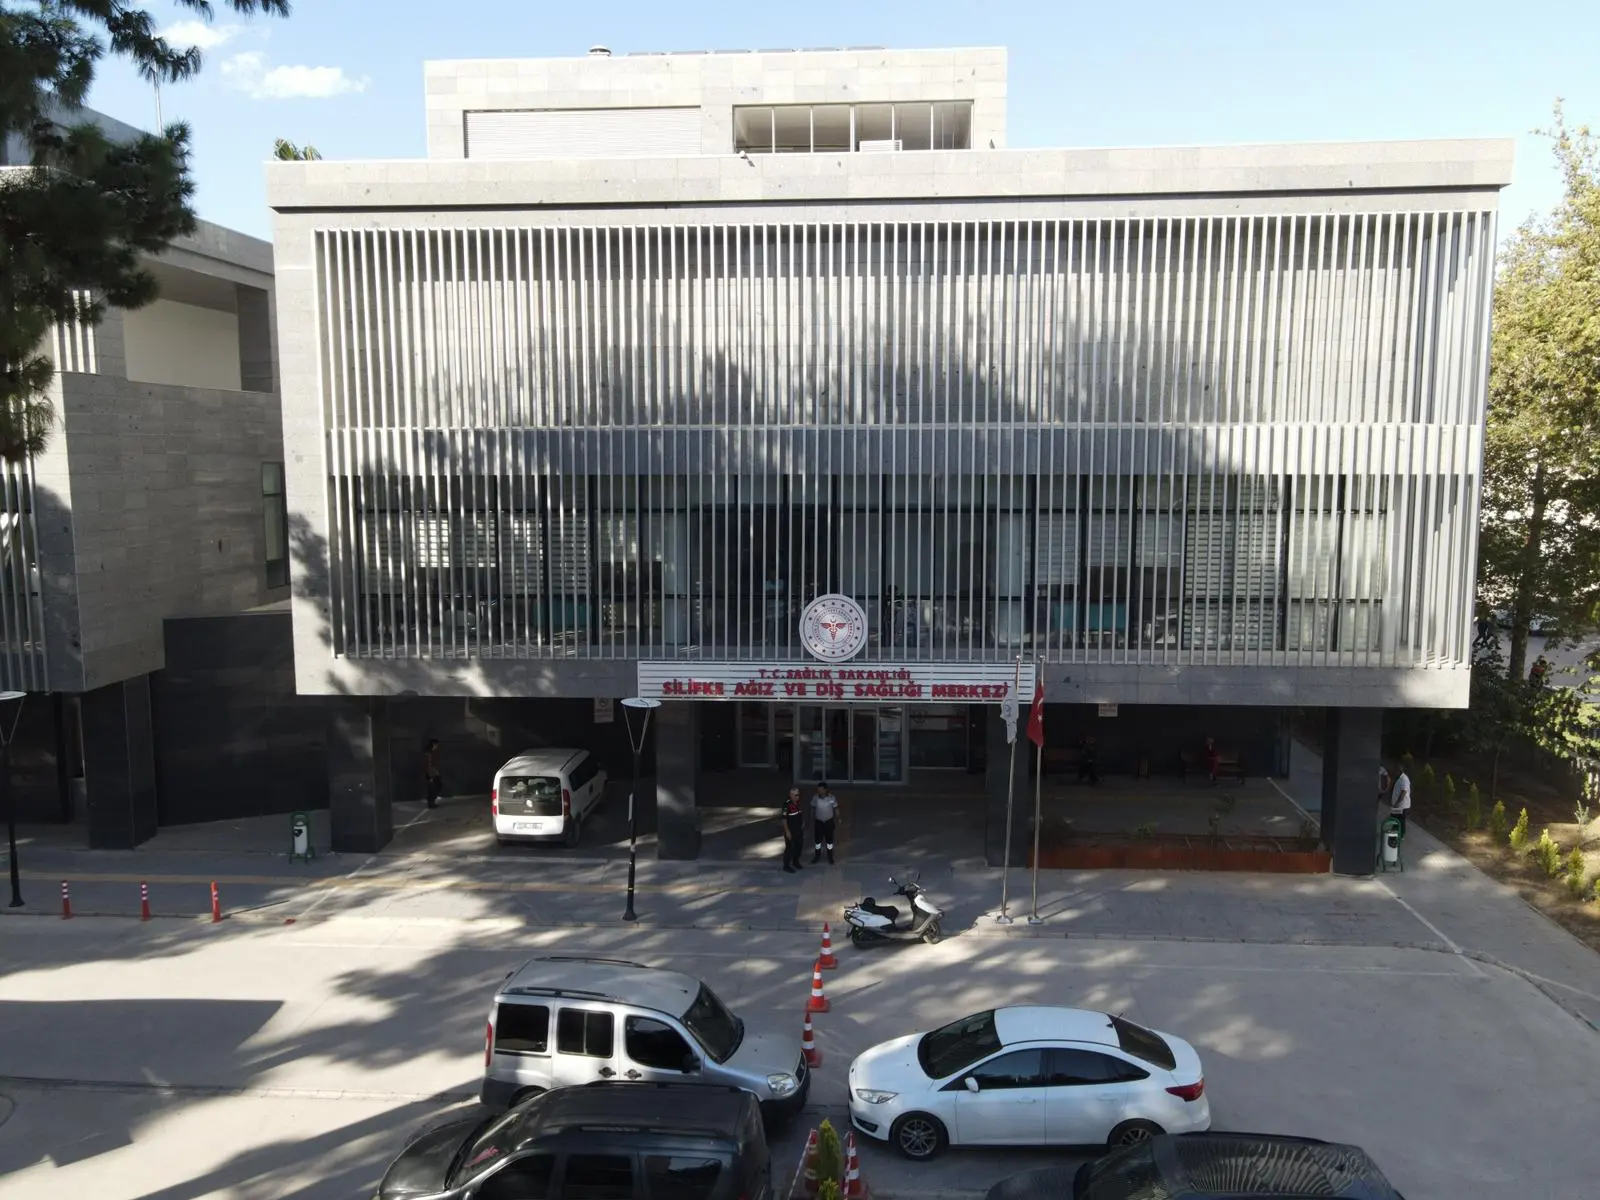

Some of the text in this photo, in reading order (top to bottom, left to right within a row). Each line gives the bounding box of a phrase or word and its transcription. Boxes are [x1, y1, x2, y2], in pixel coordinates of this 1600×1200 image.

[838, 667, 911, 680] BAKANLIĞI
[662, 678, 1008, 700] SİLİFKE AĞIZ VE DİŞ SAĞLIĞI MERKEZİ
